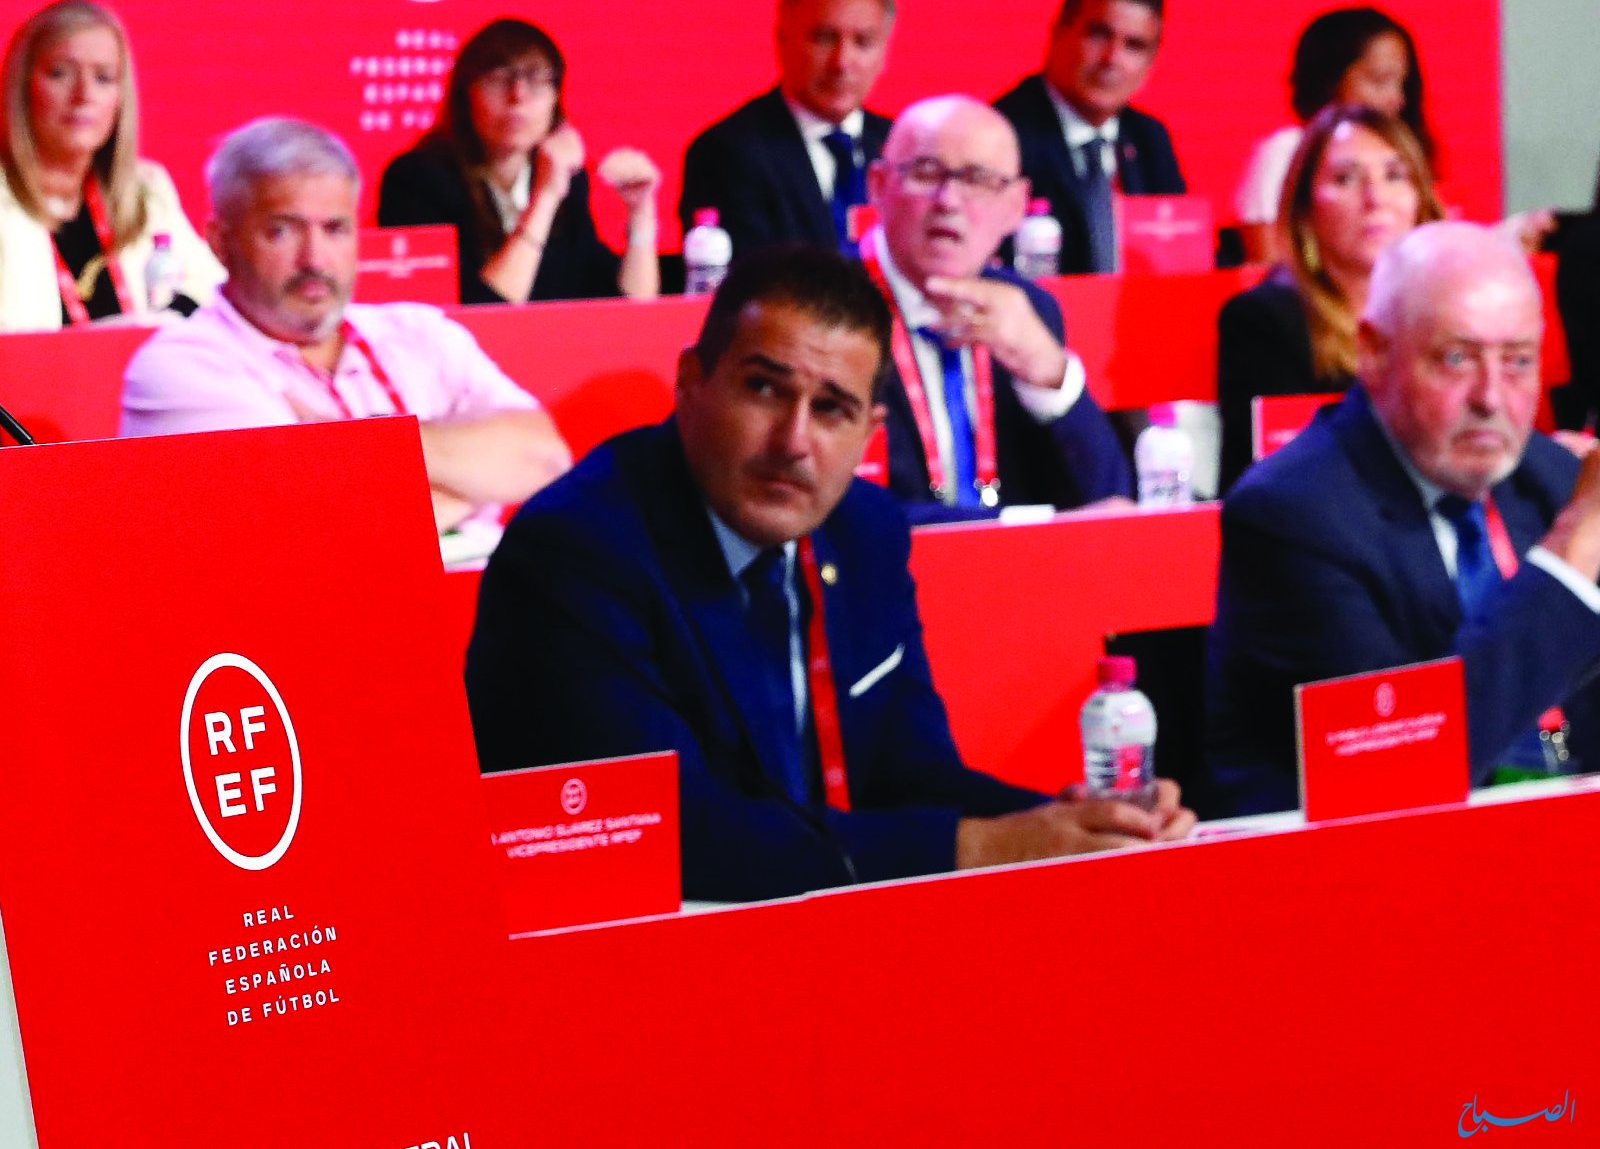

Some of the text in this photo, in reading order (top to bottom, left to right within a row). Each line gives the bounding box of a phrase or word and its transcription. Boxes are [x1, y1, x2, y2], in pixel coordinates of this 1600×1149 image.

[204, 706, 266, 756] RF
[214, 766, 277, 818] EF
[242, 905, 295, 928] REAL
[208, 925, 337, 966] FEDERACIÓN
[225, 959, 332, 995] ESPAÑOLA
[227, 988, 340, 1026] DE FÚTBOL
